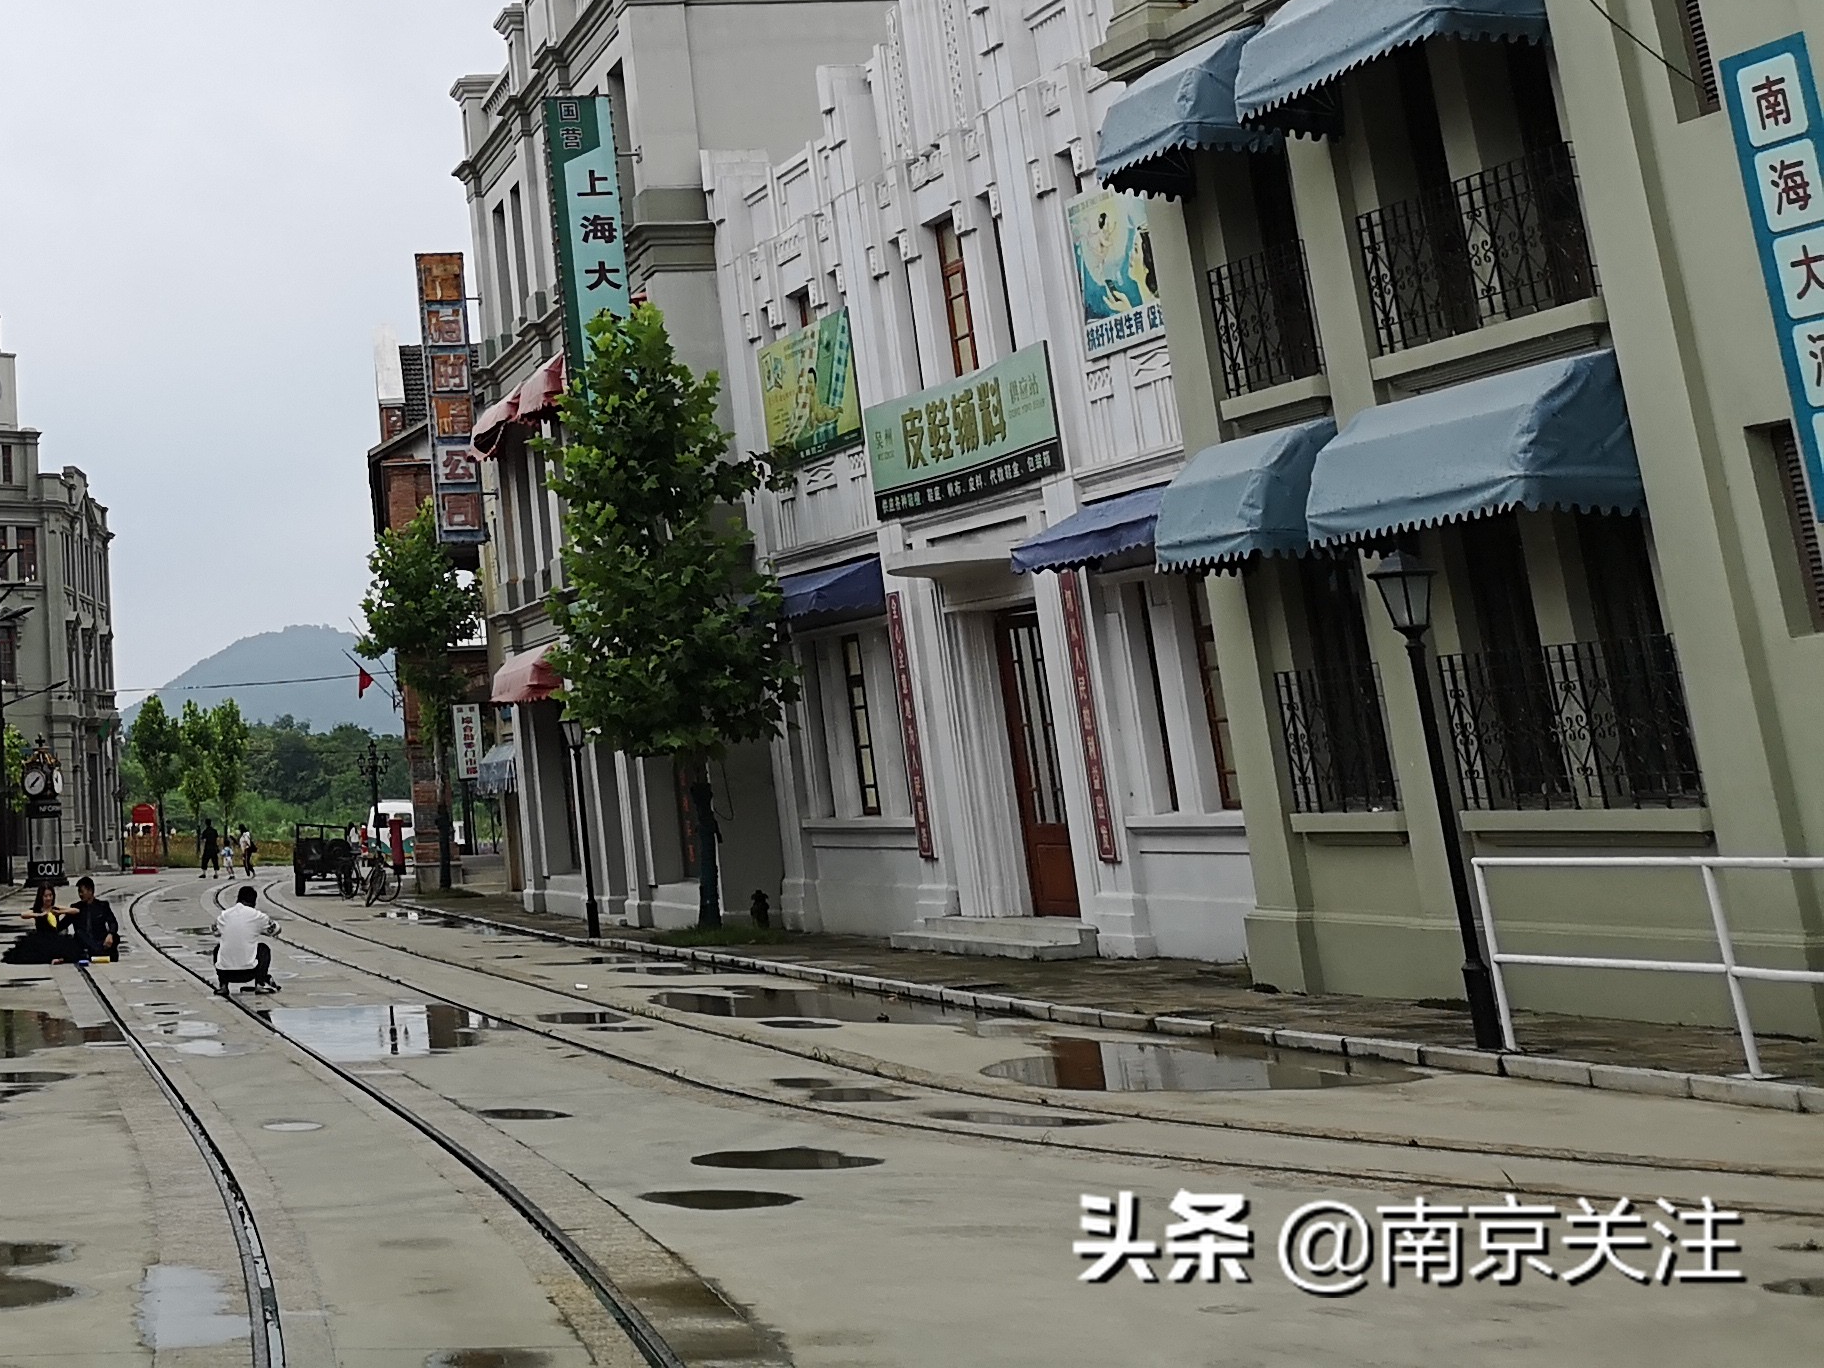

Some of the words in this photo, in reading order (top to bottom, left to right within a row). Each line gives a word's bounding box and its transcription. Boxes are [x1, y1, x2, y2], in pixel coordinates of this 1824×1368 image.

[558, 100, 583, 150] 国营
[577, 169, 624, 322] 上海大
[901, 376, 1007, 470] 皮鞋辅料
